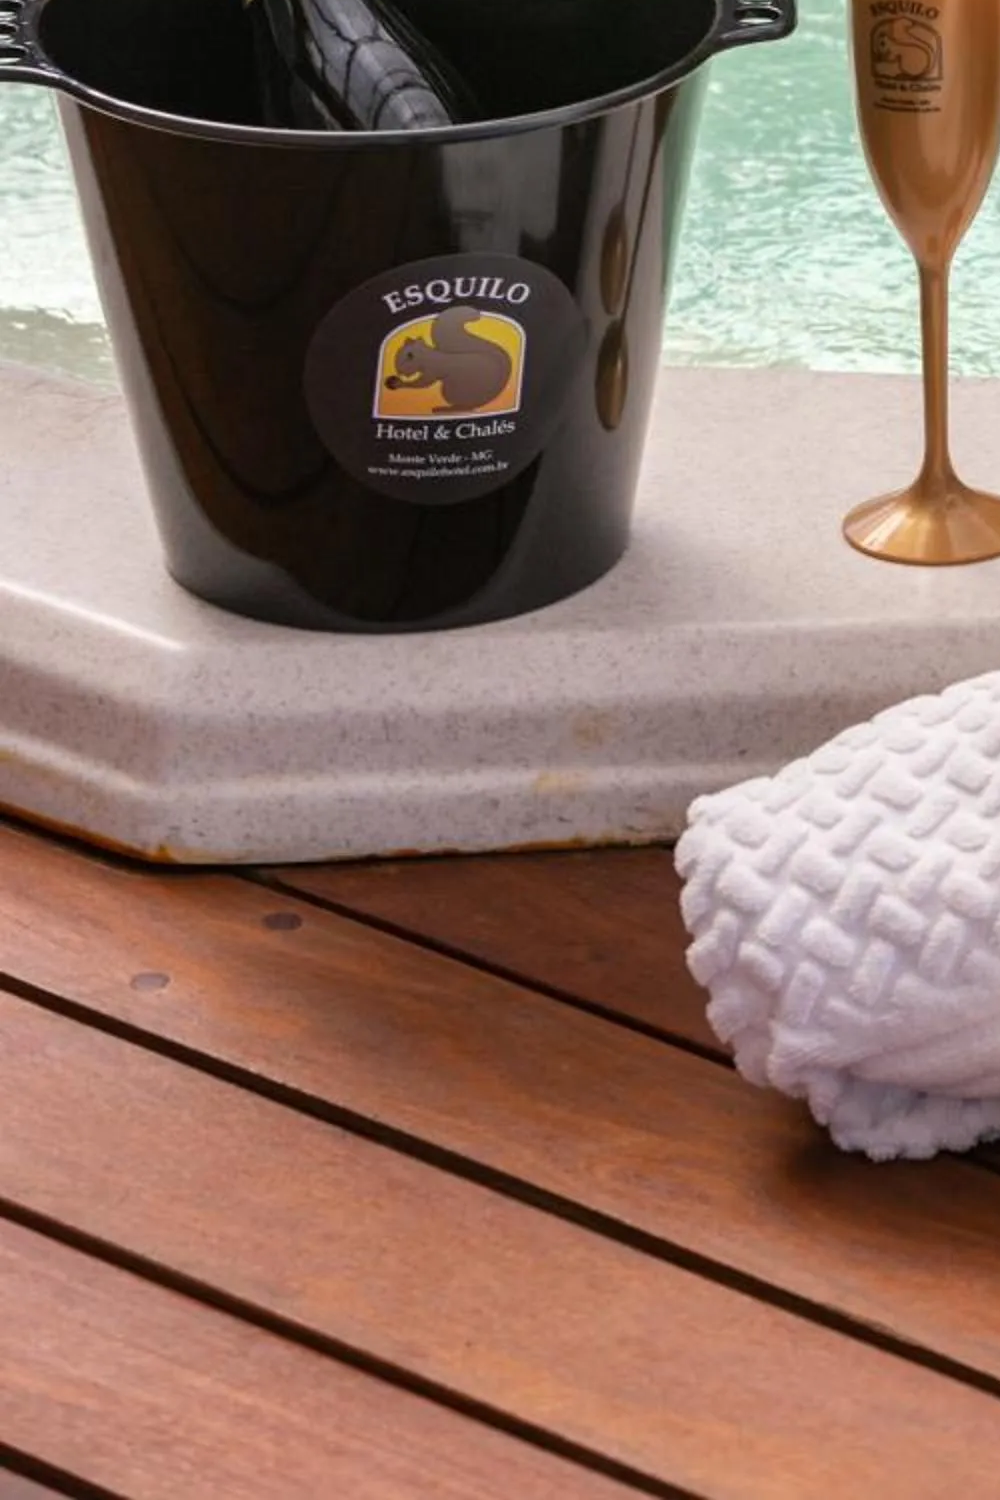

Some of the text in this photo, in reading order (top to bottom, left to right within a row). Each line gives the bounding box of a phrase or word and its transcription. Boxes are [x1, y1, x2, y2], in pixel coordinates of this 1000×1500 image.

[383, 277, 531, 313] ESQUILO
[376, 419, 516, 440] Hotel & Chalés
[388, 453, 426, 463] Monte
[428, 453, 462, 463] Verde
[471, 449, 493, 461] MG
